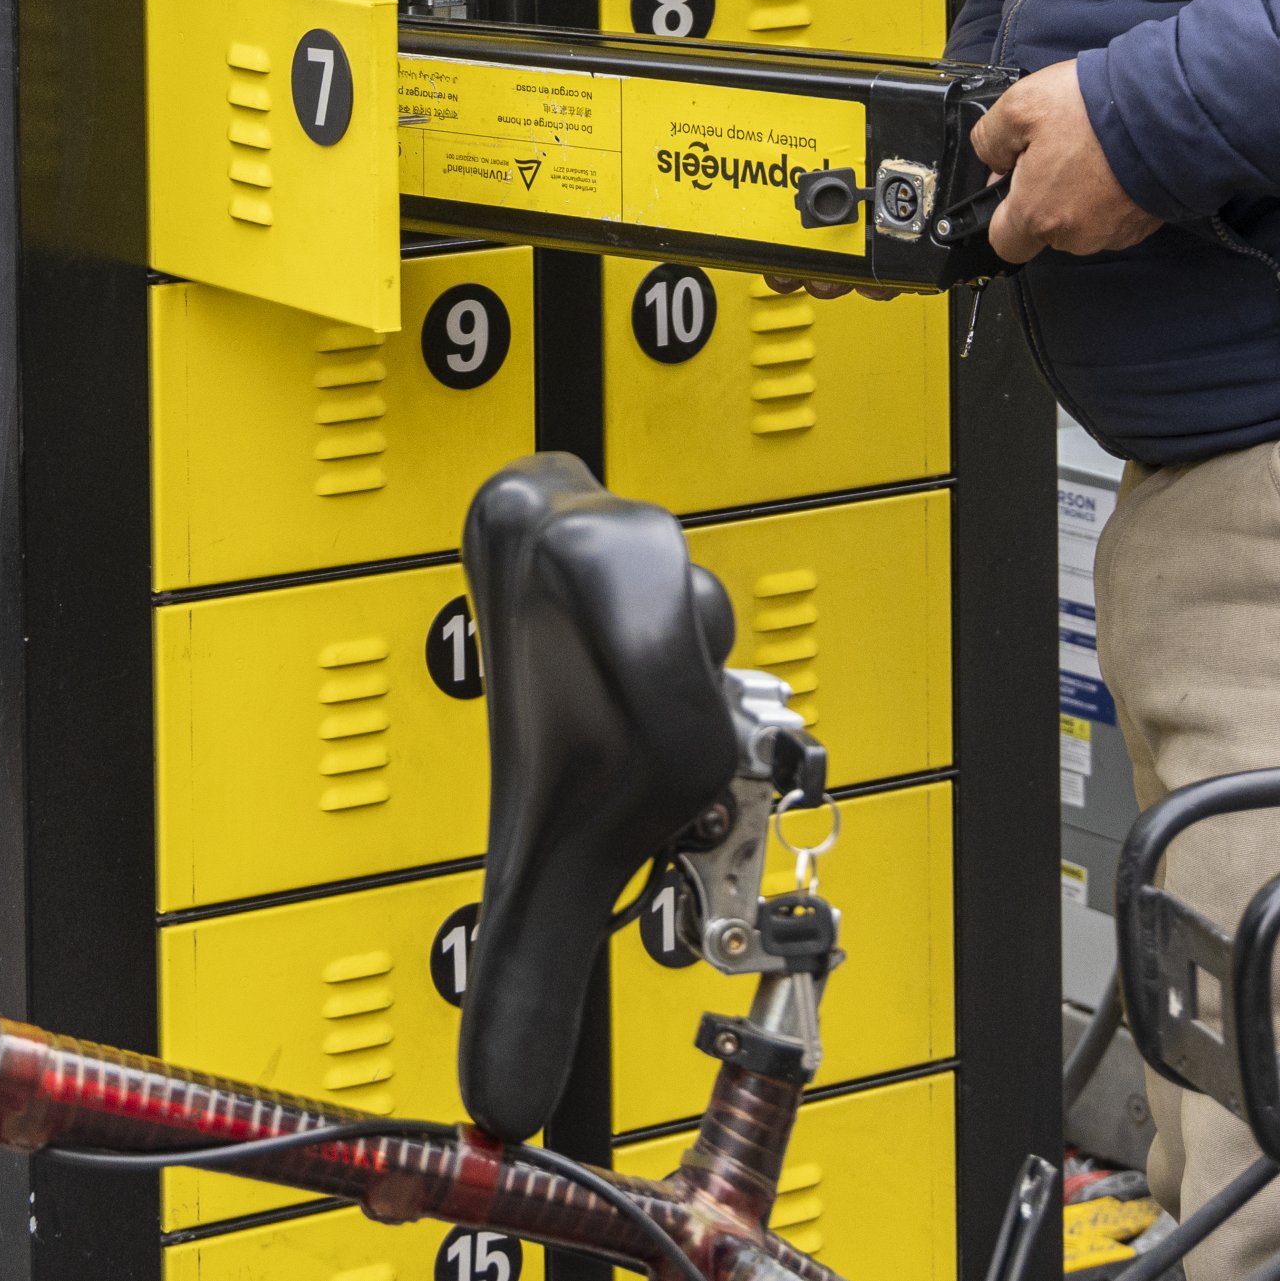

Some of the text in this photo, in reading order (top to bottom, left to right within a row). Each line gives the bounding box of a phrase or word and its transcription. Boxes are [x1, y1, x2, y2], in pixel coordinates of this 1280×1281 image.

[307, 47, 335, 127] 7
[447, 93, 458, 102] Ne
[516, 84, 593, 100] No cargar en casa
[497, 115, 593, 134] Do not charge at home
[670, 121, 817, 152] battery swap network
[645, 276, 704, 347] 10
[446, 299, 488, 372] 9
[447, 1231, 511, 1281] 15
